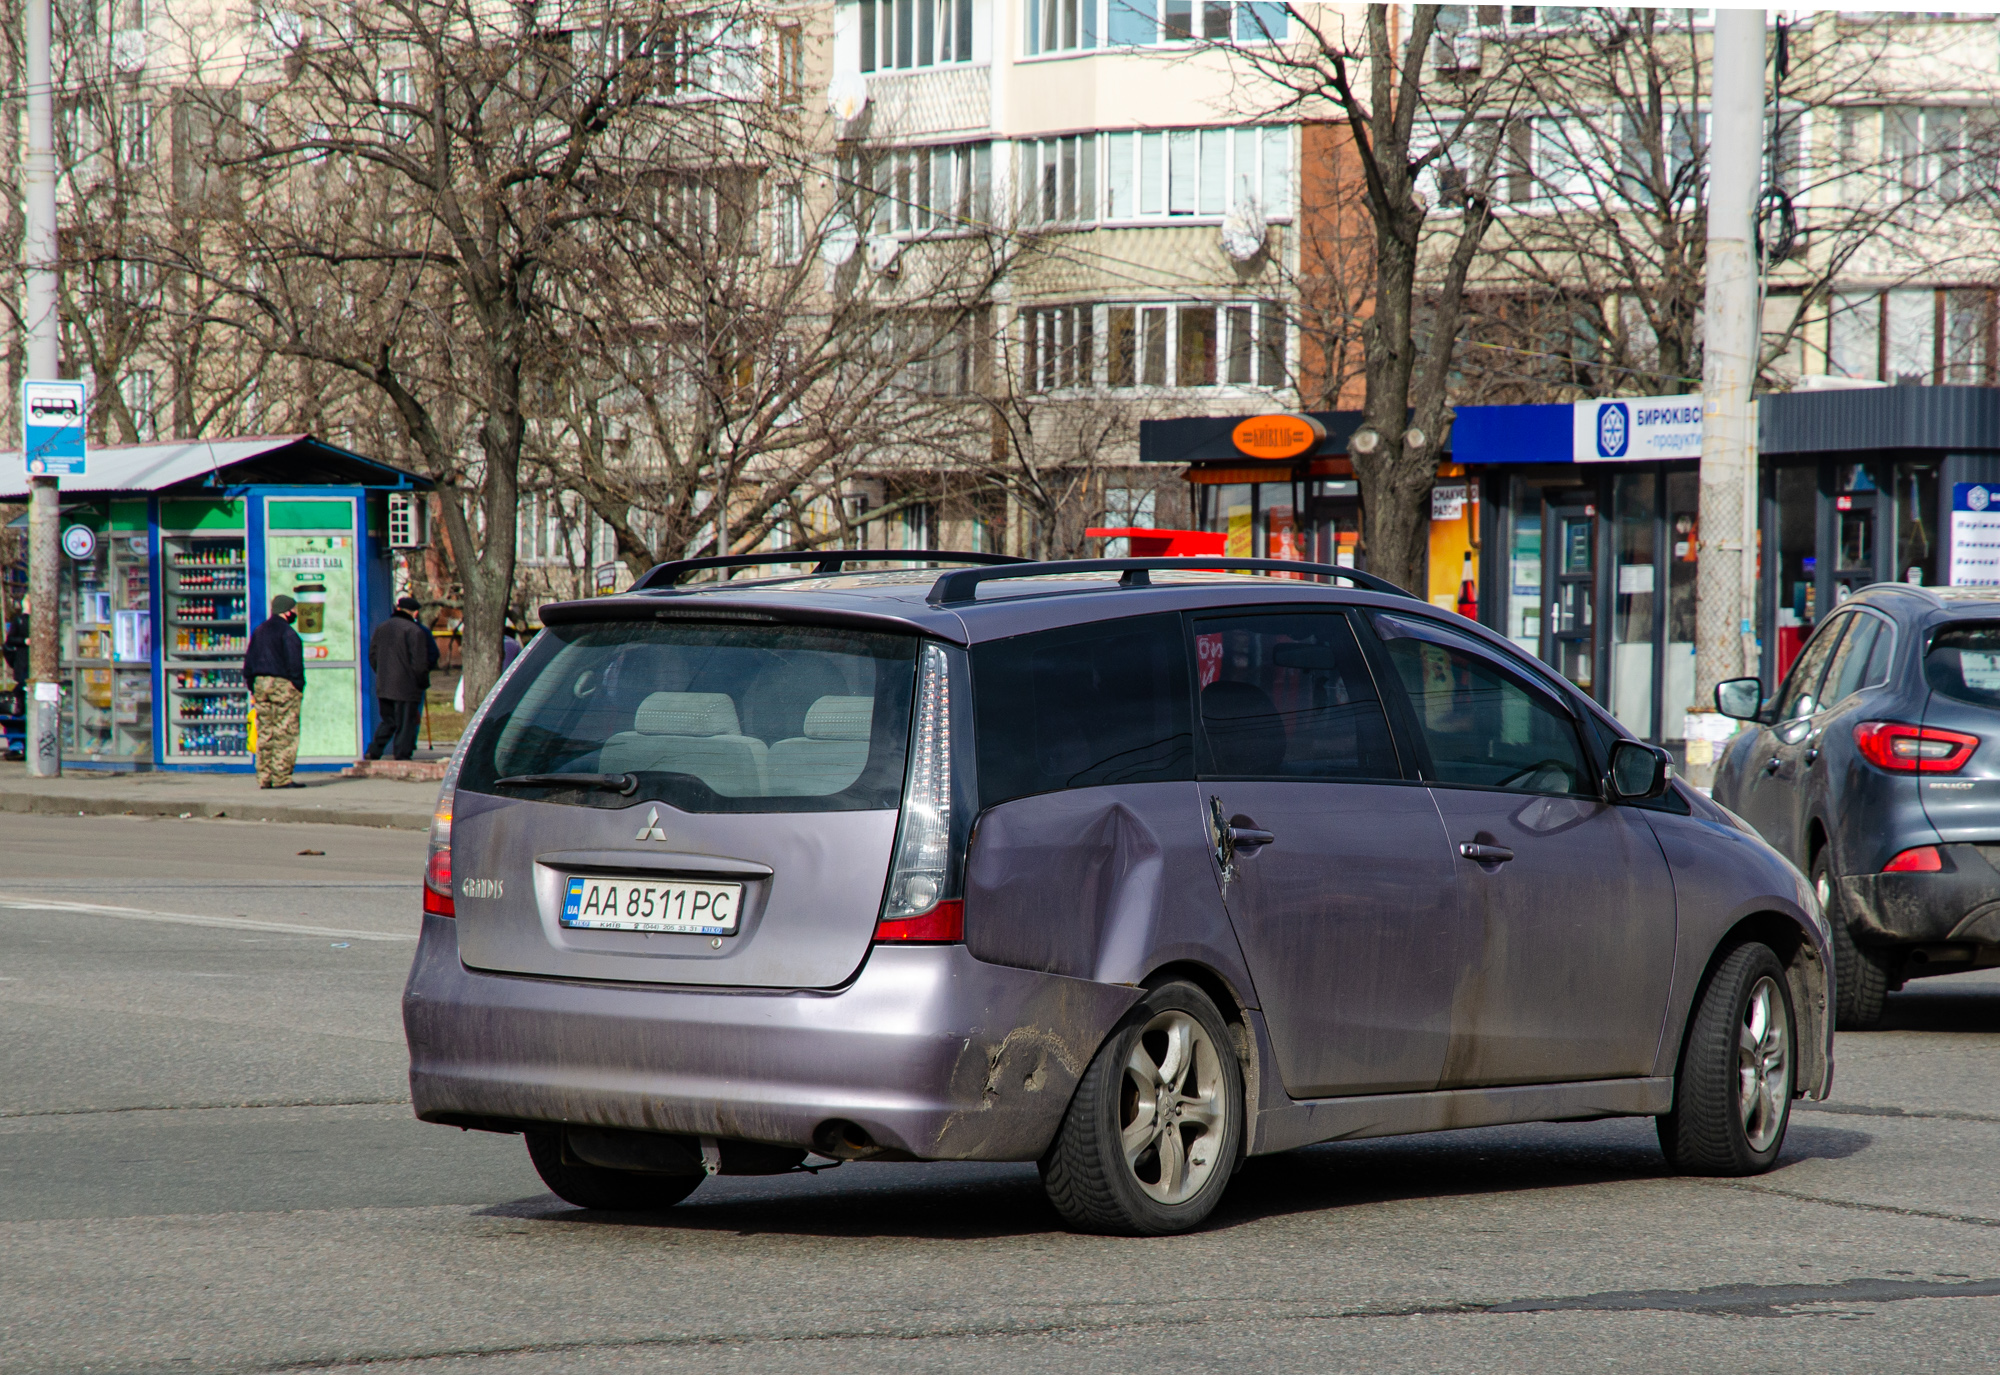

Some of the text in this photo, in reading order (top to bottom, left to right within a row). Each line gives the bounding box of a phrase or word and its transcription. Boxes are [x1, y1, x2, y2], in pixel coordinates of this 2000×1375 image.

[323, 557, 343, 568] КАВА
[462, 877, 504, 899] GRANDIS
[567, 905, 578, 915] UA
[583, 885, 731, 921] AA 8511 PC
